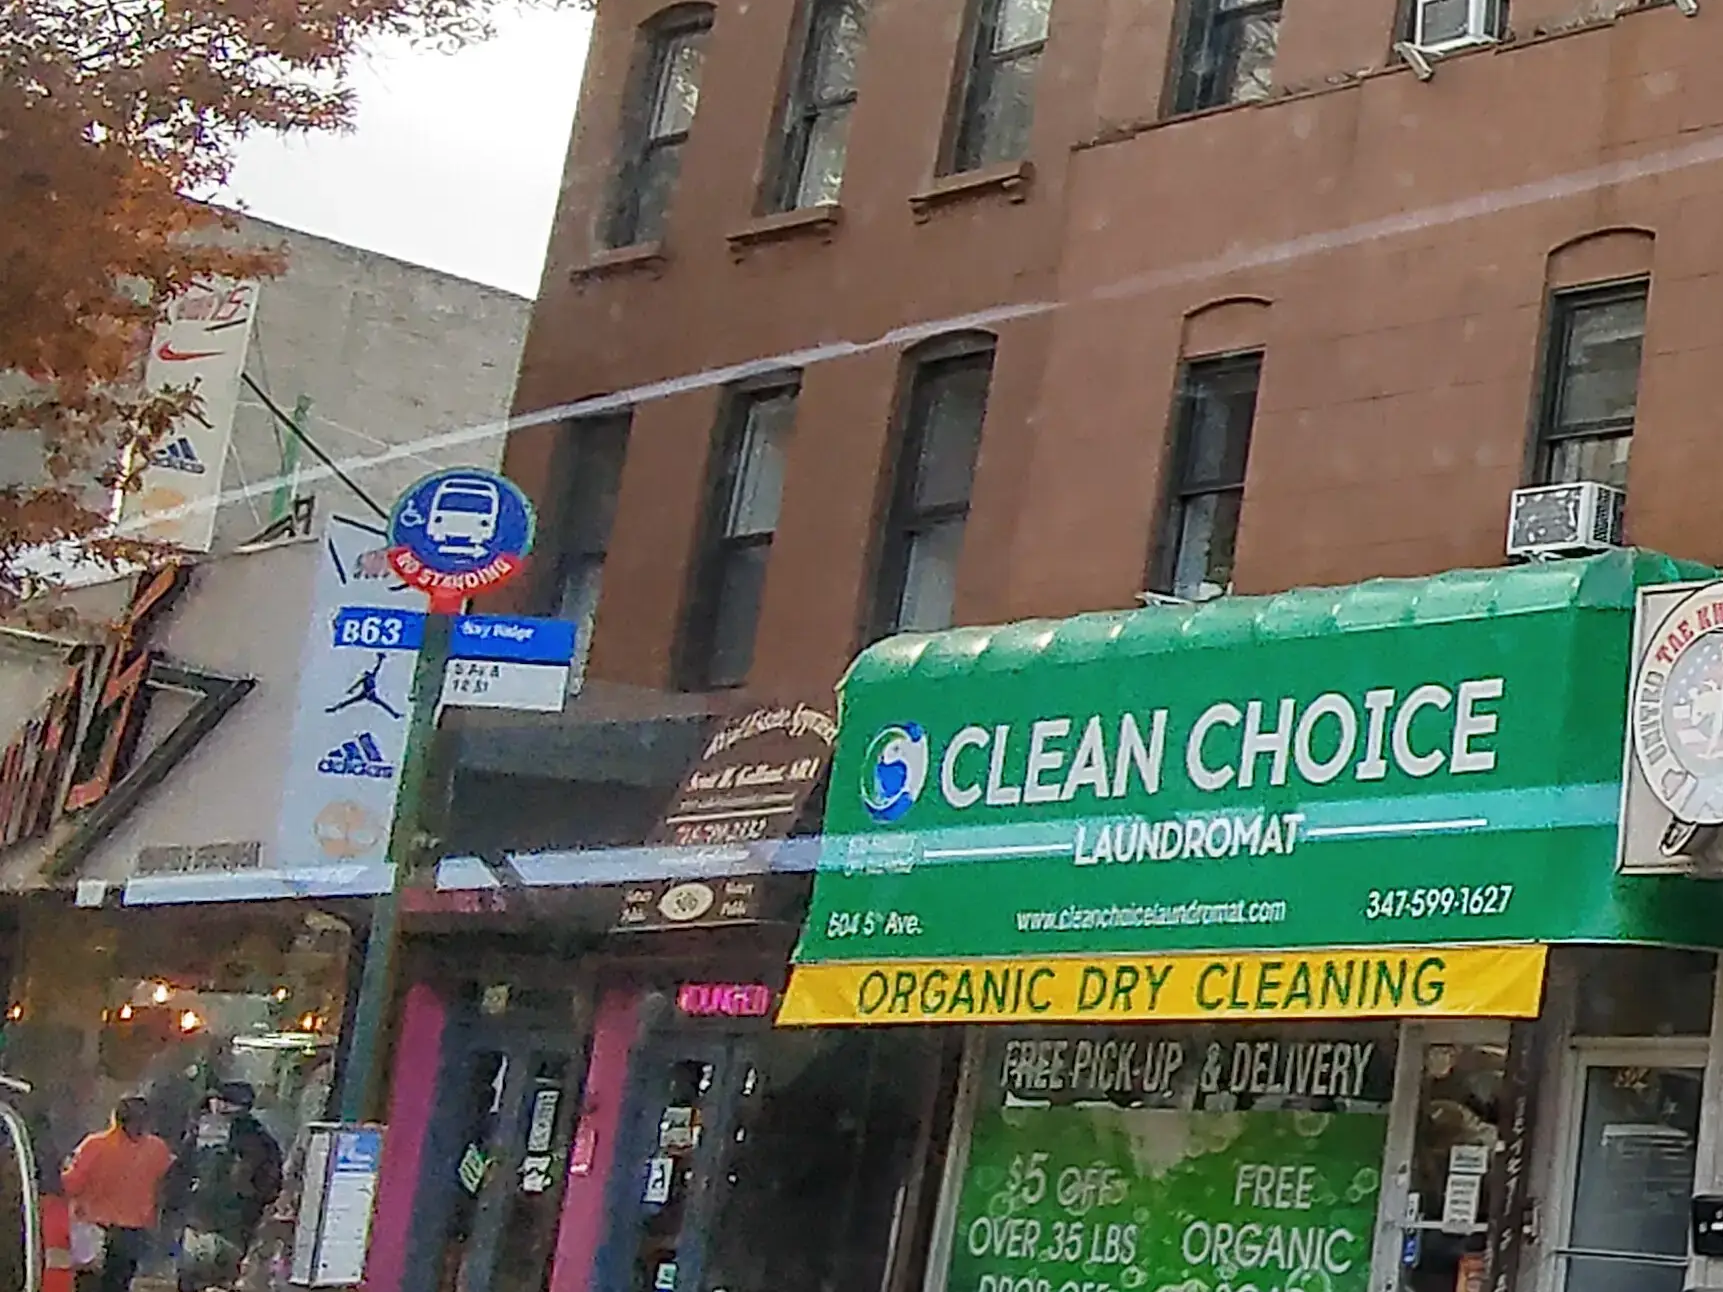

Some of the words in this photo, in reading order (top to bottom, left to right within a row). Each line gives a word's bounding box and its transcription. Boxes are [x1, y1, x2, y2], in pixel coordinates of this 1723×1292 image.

[341, 616, 404, 646] B63
[318, 758, 394, 779] adidas
[940, 709, 1168, 809] CLEAN
[1186, 677, 1504, 791] CHOICE
[1073, 813, 1305, 866] LAUNDROMAT
[1366, 884, 1513, 920] 347-599-1627
[857, 967, 1056, 1015] ORGANIC
[1077, 963, 1174, 1013] DRY
[1195, 956, 1447, 1011] CLEANING
[1000, 1039, 1068, 1091] FREE
[1071, 1039, 1184, 1095] PICK-UP
[1200, 1041, 1222, 1093] &
[1229, 1041, 1373, 1096] DELIVERY
[1006, 1151, 1050, 1205] $5
[1056, 1165, 1123, 1208] OFF
[1234, 1163, 1317, 1210] FREE
[968, 1216, 1041, 1260] OVER
[1047, 1221, 1084, 1264] 35
[1090, 1222, 1140, 1266] LBS
[1181, 1219, 1356, 1274] ORGANIC
